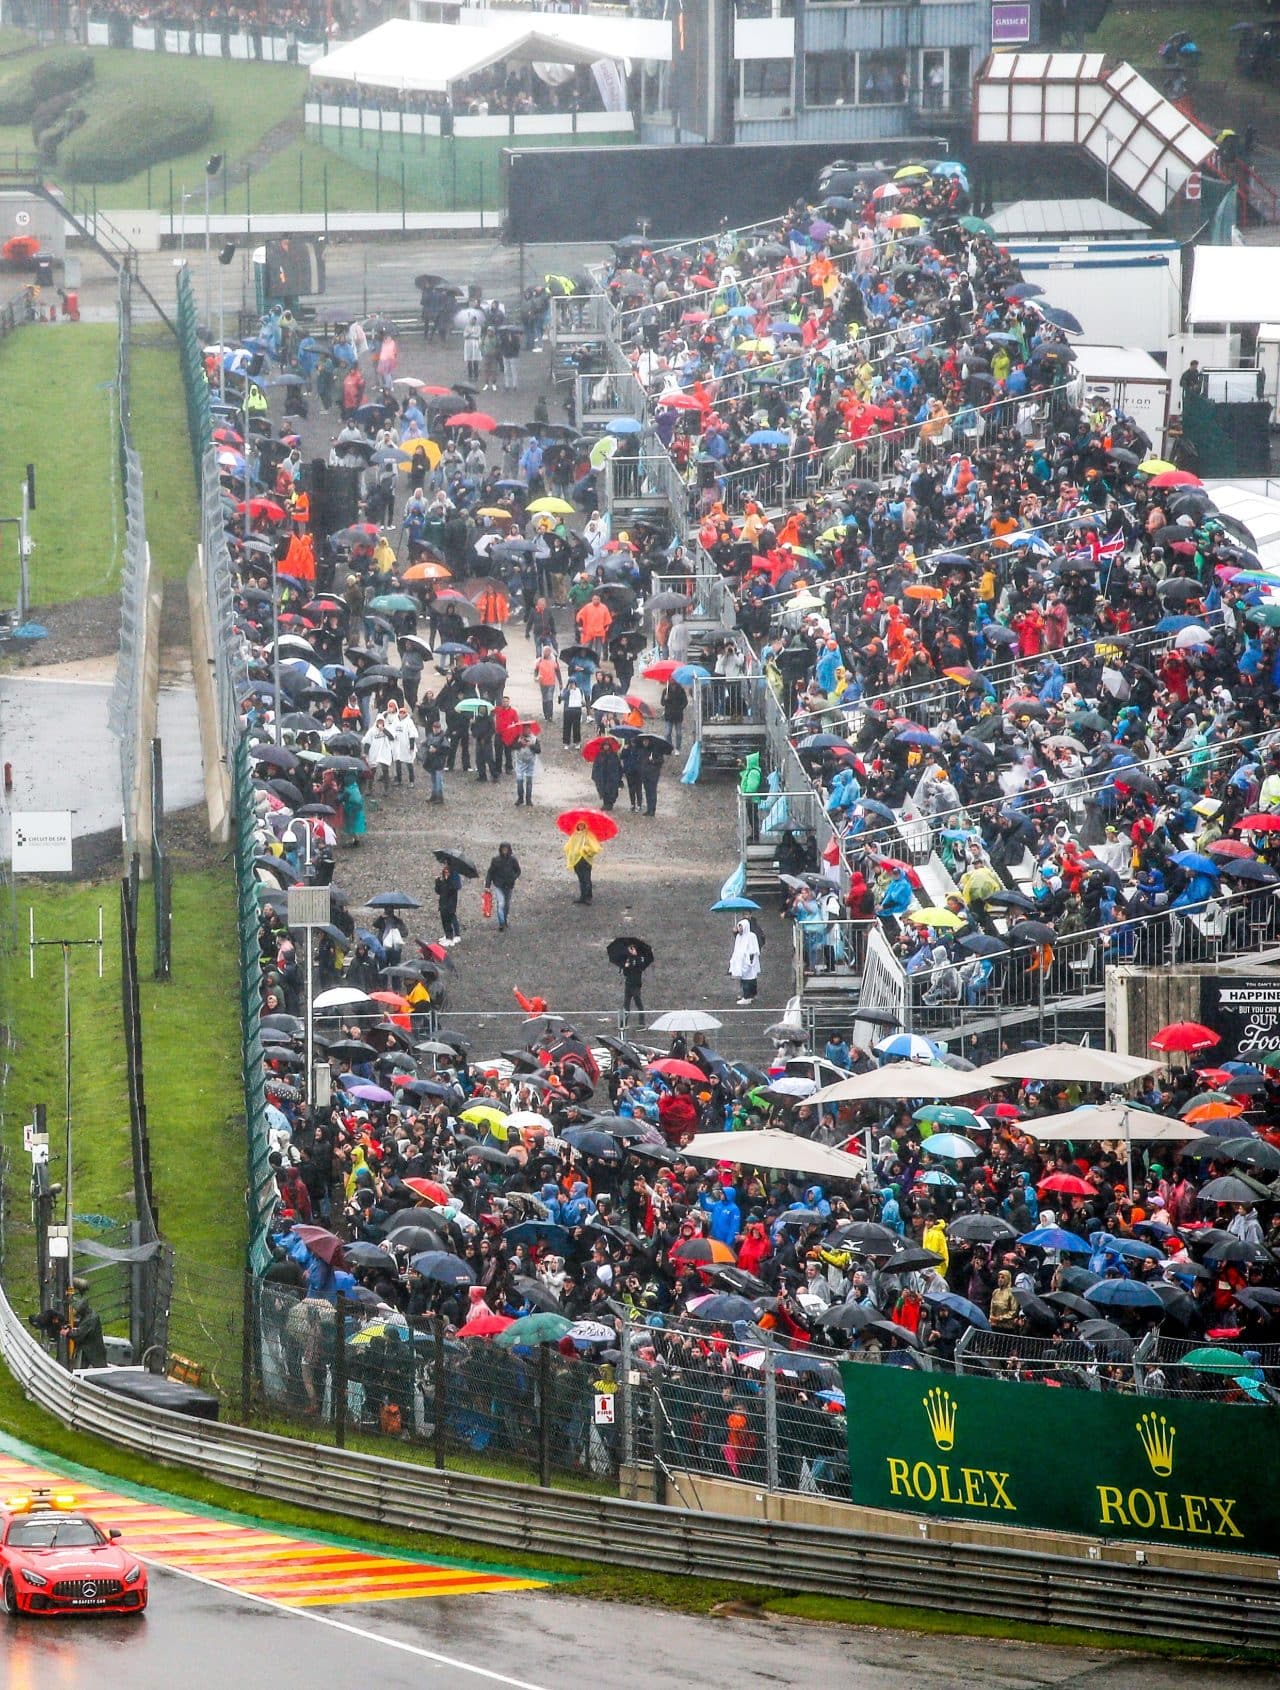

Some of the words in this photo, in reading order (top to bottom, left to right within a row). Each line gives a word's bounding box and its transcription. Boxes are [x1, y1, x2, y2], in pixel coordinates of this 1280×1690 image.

[1250, 1014, 1279, 1026] OUR
[886, 1457, 1017, 1511] ROLEX
[1095, 1485, 1245, 1538] ROLEX
